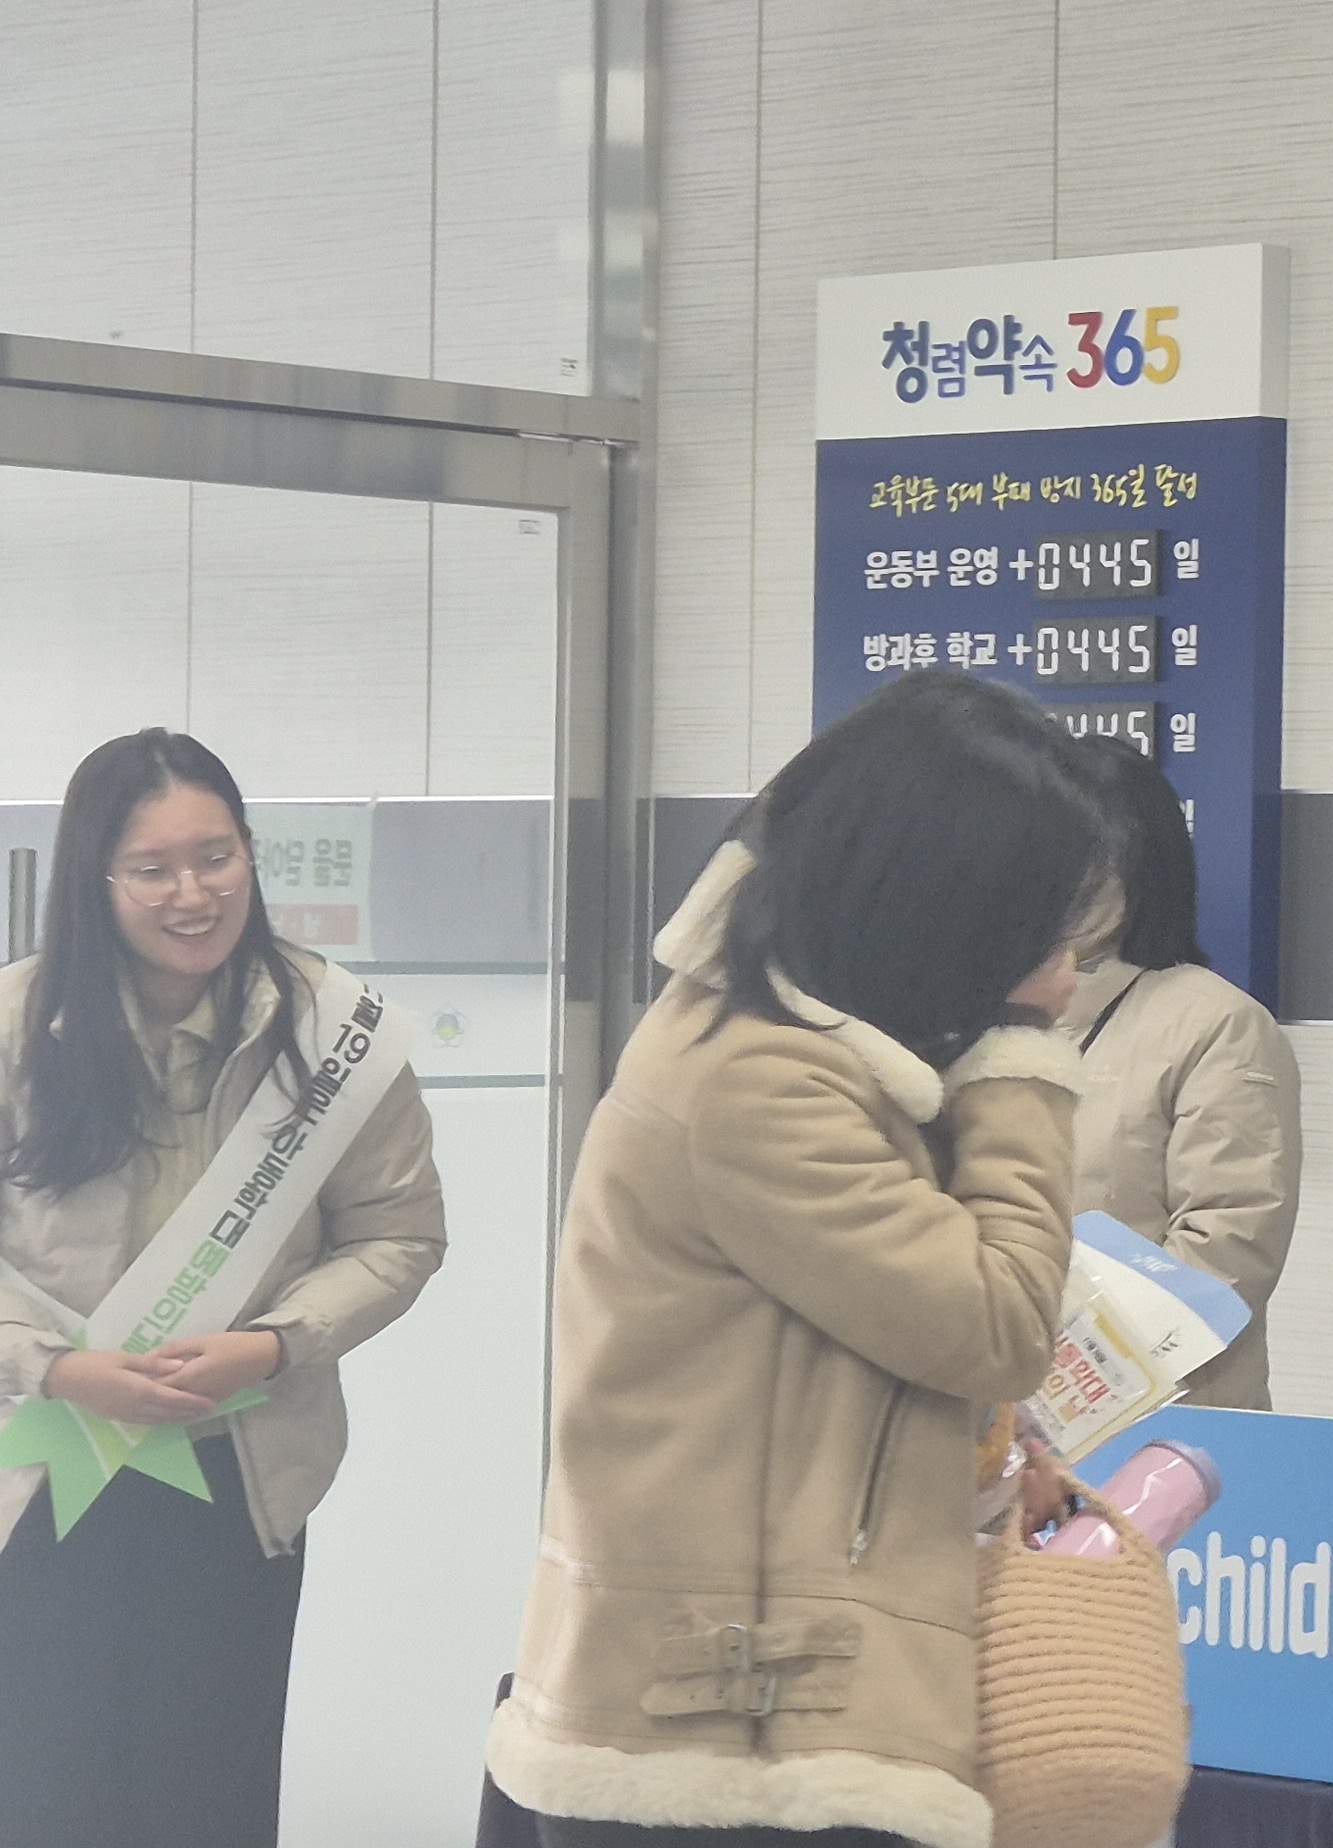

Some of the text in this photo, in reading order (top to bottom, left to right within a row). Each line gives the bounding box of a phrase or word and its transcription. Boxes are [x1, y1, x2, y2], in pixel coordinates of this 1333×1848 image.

[882, 306, 1180, 403] 청렴약속 365
[870, 476, 938, 516] 교육부문
[946, 485, 984, 511] 5대
[1040, 477, 1082, 503] 방지
[1091, 464, 1145, 507] 365일
[1153, 464, 1198, 507] 달성
[864, 550, 939, 589] 운동부
[947, 547, 999, 586] 운영
[1173, 538, 1200, 580] 일
[862, 633, 938, 672] 방과후
[946, 632, 998, 669] 학교
[1171, 624, 1199, 666] 일
[1170, 712, 1197, 753] 일
